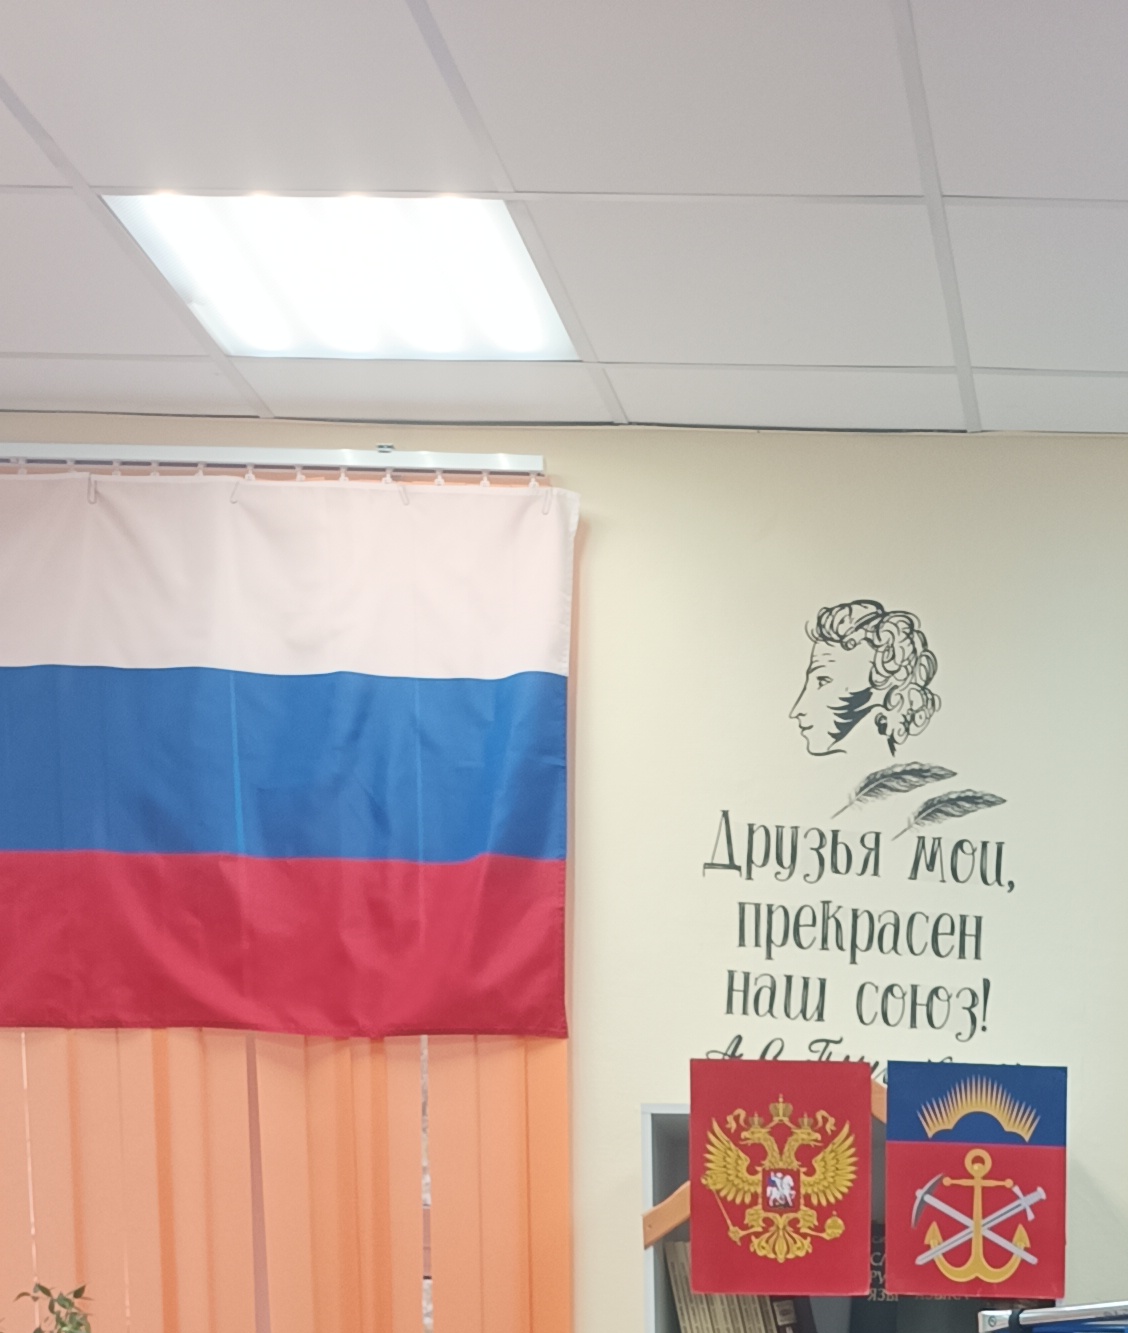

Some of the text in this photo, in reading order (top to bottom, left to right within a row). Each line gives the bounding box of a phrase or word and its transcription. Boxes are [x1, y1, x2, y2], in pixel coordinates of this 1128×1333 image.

[702, 809, 1016, 893] Друзья мои,
[737, 899, 983, 964] прекрасен
[724, 968, 992, 1042] наш союз!
